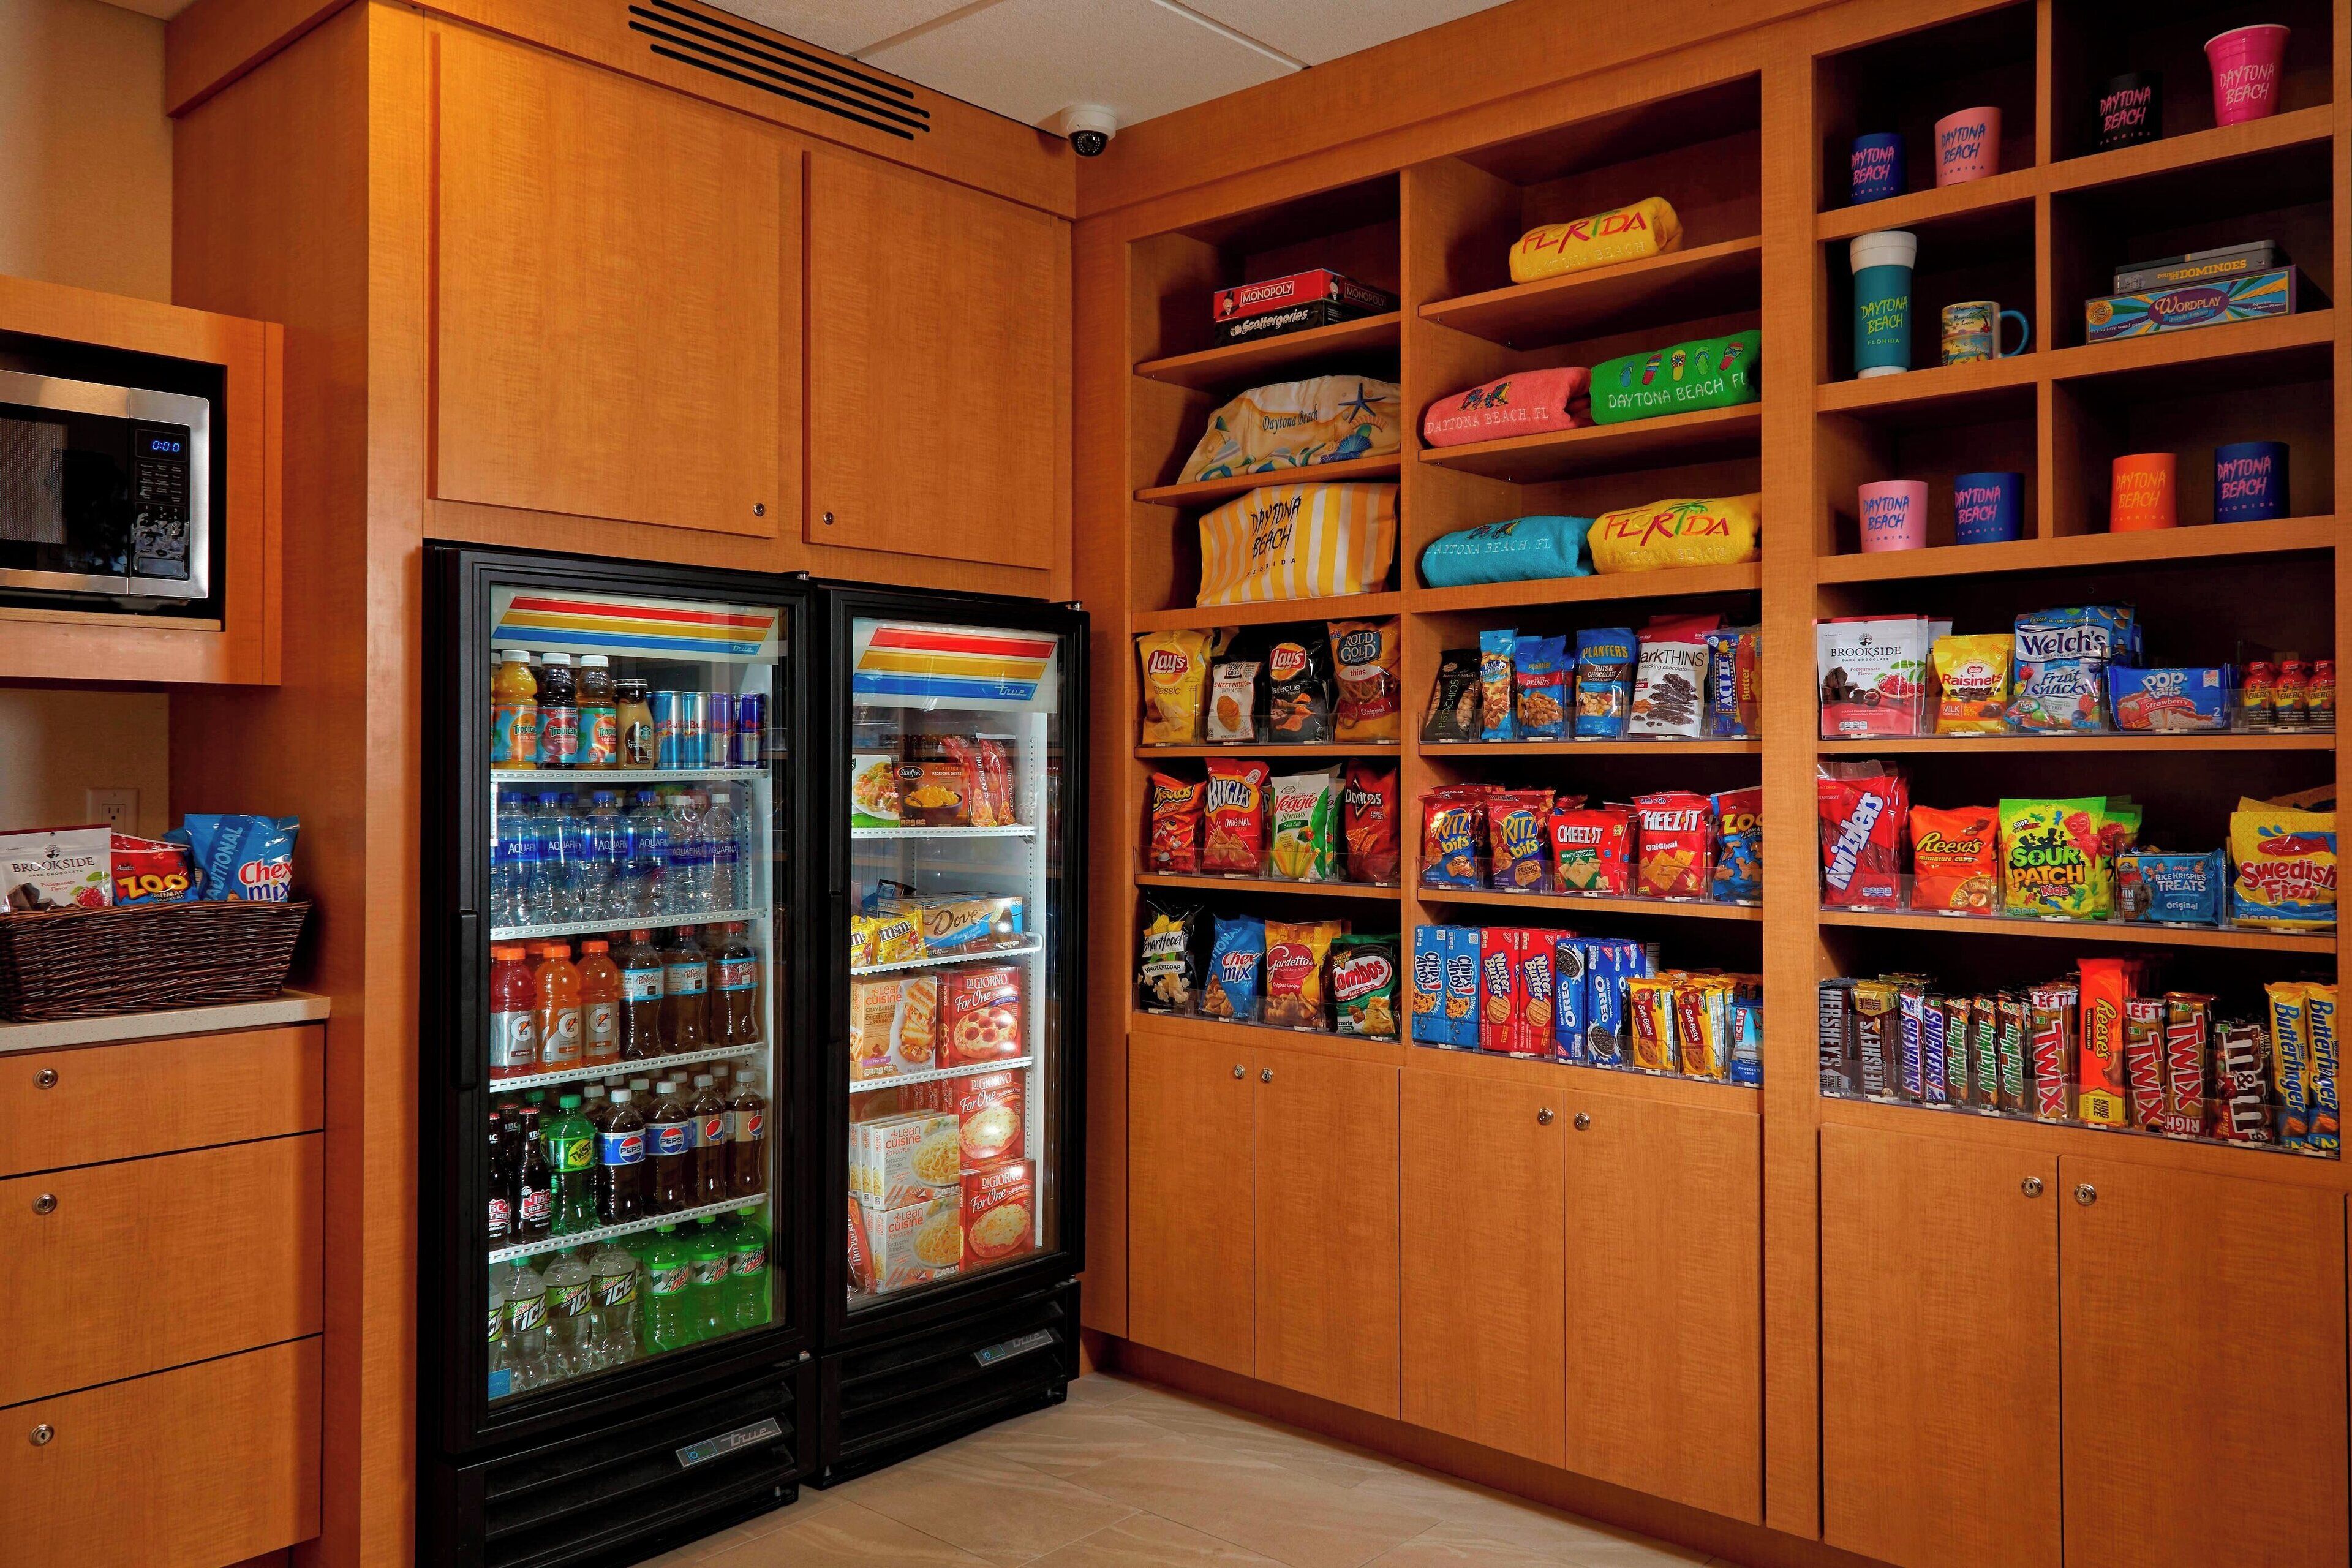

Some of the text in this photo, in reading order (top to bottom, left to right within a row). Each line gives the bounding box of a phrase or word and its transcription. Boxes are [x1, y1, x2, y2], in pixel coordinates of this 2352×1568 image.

[2220, 62, 2275, 89] DAYTONA
[2100, 86, 2152, 116] DAYTONA
[2226, 83, 2270, 106] BEACH
[2103, 107, 2147, 132] BEACH
[1942, 123, 1986, 149] DAYTONA
[1852, 145, 1894, 170] DAYTONA
[1943, 143, 1980, 165] BEACH
[1853, 164, 1891, 186] BEACH
[2180, 259, 2247, 279] DOMINOES
[1243, 284, 1292, 303] MONOPOLY
[1347, 287, 1385, 306] MONOPOLY
[1860, 296, 1909, 320] DAYTONA
[1867, 313, 1904, 335] BEACH
[1608, 389, 1672, 409] DAYTONA
[1676, 378, 1725, 400] BEACH
[1262, 404, 1318, 435] Daytona Beach
[153, 440, 180, 452] 0:00
[2217, 456, 2271, 481] DAYTONA
[2116, 470, 2166, 491] DAYTONA
[2222, 477, 2268, 500] BEACH
[1864, 494, 1910, 516] DAYTONA
[1954, 485, 2002, 508] DAYTONA
[2118, 491, 2162, 510] BEACH
[1251, 496, 1302, 537] DAYTONA
[1868, 513, 1905, 531] BEACH
[1959, 505, 1997, 525] BEACH
[1253, 524, 1292, 559] BEACH
[1247, 558, 1296, 577] FLORIDA
[1345, 632, 1374, 647] ROLD
[2019, 630, 2106, 656] Welch's
[1150, 652, 1187, 673] Lay's
[1272, 650, 1305, 670] Lay's
[1341, 644, 1376, 662] GOLD
[1582, 645, 1629, 658] PLANTERS
[1831, 646, 1902, 657] BROOKSIDE
[1741, 668, 1751, 701] Butter
[1941, 673, 2003, 687] Raisinets
[2041, 669, 2082, 685] Fruit
[2031, 681, 2087, 696] snacks
[2150, 685, 2182, 699] tarts
[1360, 705, 1385, 717] Original
[1439, 680, 1459, 728] PISTACHIOS
[2145, 698, 2188, 710] Strawberry
[2213, 707, 2220, 716] 2
[1207, 777, 1251, 813] BUGLES
[1346, 789, 1382, 805] Doritos
[1225, 818, 1251, 827] ORIGINAL
[1436, 812, 1469, 840] RITZ
[1502, 816, 1537, 844] RITZ
[2013, 819, 2029, 829] SOUR
[672, 846, 701, 856] AQUAFINA
[709, 846, 739, 854] AQUAFINA
[1441, 835, 1471, 854] bits
[1510, 839, 1539, 859] bits
[1917, 832, 1983, 853] Reese's
[12, 857, 95, 873] BROOKSIDE
[2011, 846, 2081, 867] SOUR
[2013, 865, 2085, 888] PATCH
[2173, 872, 2207, 881] KRISPIES
[2241, 859, 2337, 888] Swedish
[117, 874, 189, 900] ZOO
[2040, 884, 2069, 897] Kids
[2157, 879, 2206, 892] TREATS
[2261, 880, 2318, 905] Fish
[2166, 901, 2198, 911] Original
[923, 909, 979, 936] Dove
[1144, 965, 1159, 974] WHITE
[1484, 959, 1502, 998] Butter
[1493, 952, 1510, 993] Nutter
[1525, 960, 1543, 1000] Butter
[1534, 954, 1551, 997] Nutter
[865, 993, 902, 1006] cuisine
[879, 984, 902, 995] Lean
[1594, 976, 1608, 1022] OREO
[955, 994, 972, 1012] For
[973, 990, 991, 1007] One
[1562, 981, 1577, 1027] OREO
[1872, 998, 1882, 1011] SIZE
[1736, 1008, 1747, 1034] CLIF
[1820, 989, 1842, 1067] HERSHEY'S
[2095, 998, 2118, 1061] Reese's
[1860, 1020, 1883, 1091] HERSHEY'S
[1925, 1009, 1944, 1087] SNICKERS
[2274, 1002, 2306, 1112] Butterfinger
[2310, 999, 2339, 1111] Butterfinger
[2034, 1020, 2066, 1115] TWIX
[2167, 1012, 2204, 1112] TWIX
[2127, 1031, 2165, 1123] TWIX
[960, 1096, 977, 1114] For
[978, 1090, 996, 1107] One
[886, 1135, 921, 1150] cuisine
[899, 1125, 921, 1138] Lean
[970, 1194, 987, 1213] For
[987, 1188, 1006, 1205] One
[888, 1216, 924, 1234] cuisine
[901, 1208, 923, 1221] Lean
